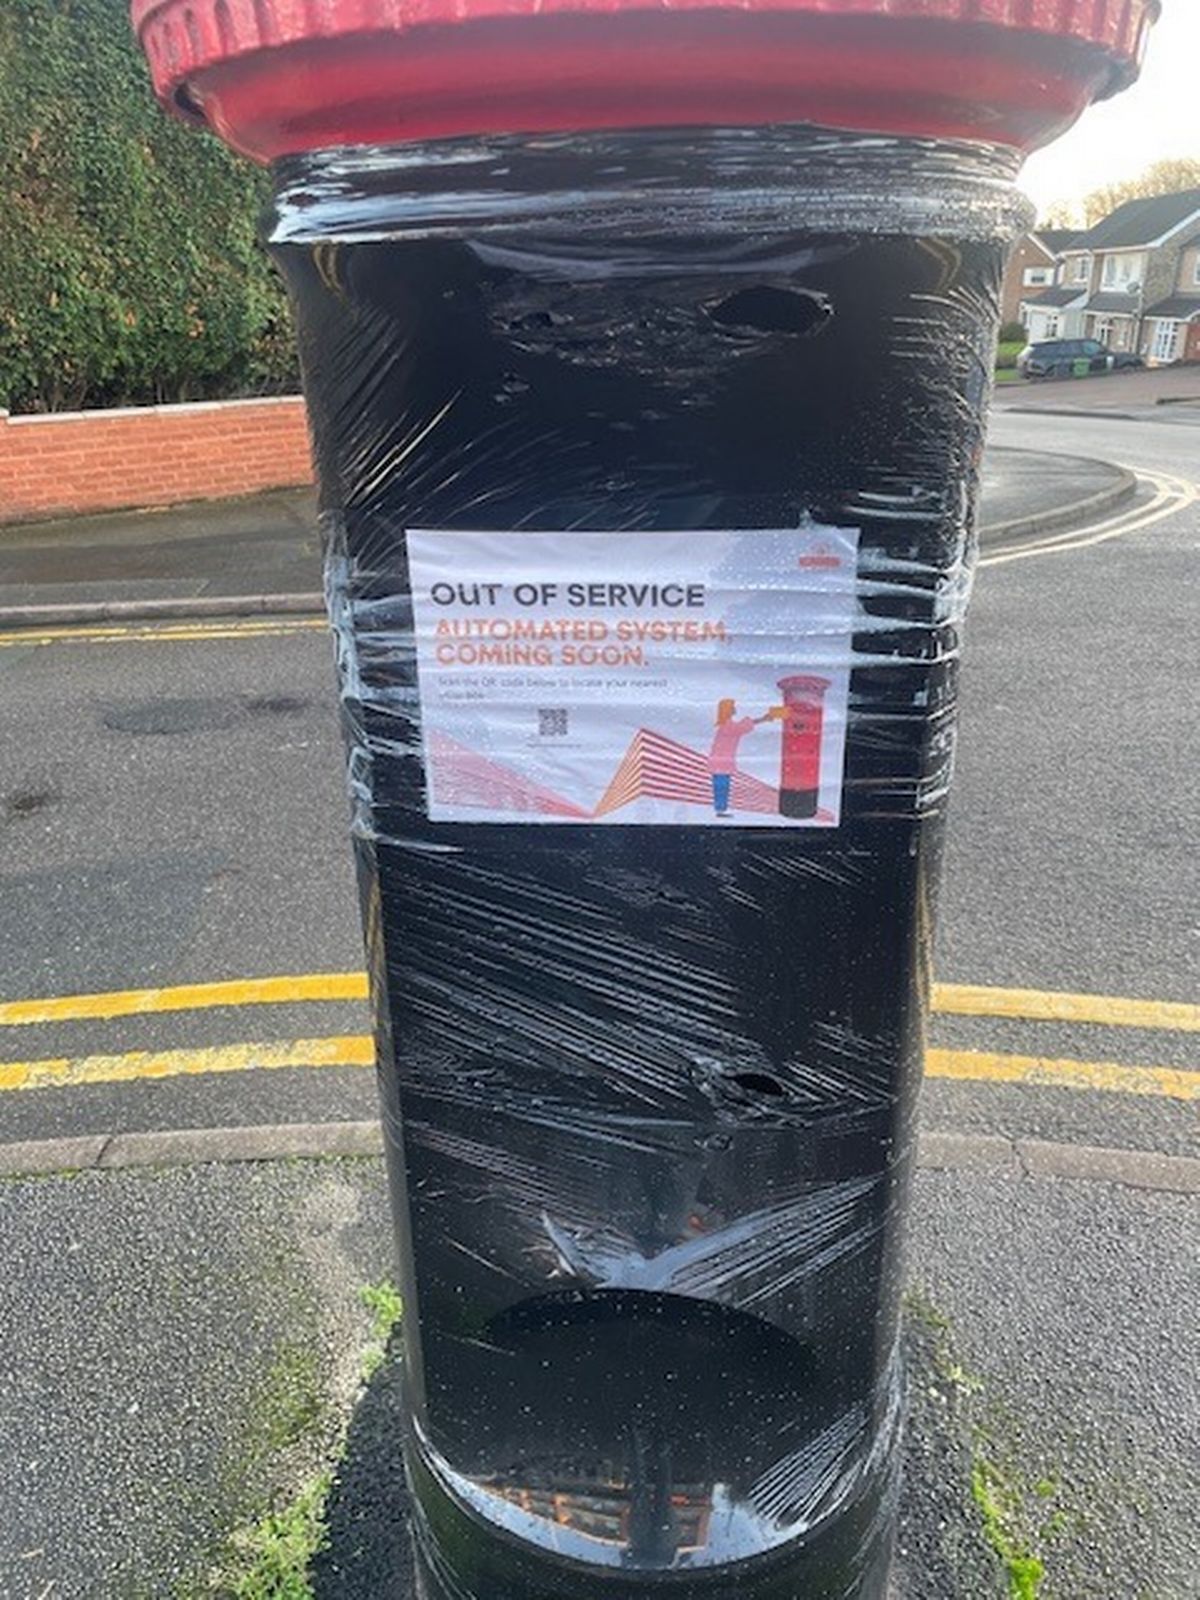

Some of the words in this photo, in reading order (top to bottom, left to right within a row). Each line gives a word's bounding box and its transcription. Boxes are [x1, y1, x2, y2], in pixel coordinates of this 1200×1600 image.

[430, 582, 503, 606] OUT
[513, 583, 557, 607] OF
[567, 583, 705, 608] SERVICE
[435, 619, 608, 641] AUTOMATED
[436, 643, 552, 665] COMING
[561, 644, 649, 666] SOON.
[481, 676, 498, 687] QR
[526, 677, 557, 687] below
[606, 679, 628, 690] your
[630, 679, 668, 688] nearest
